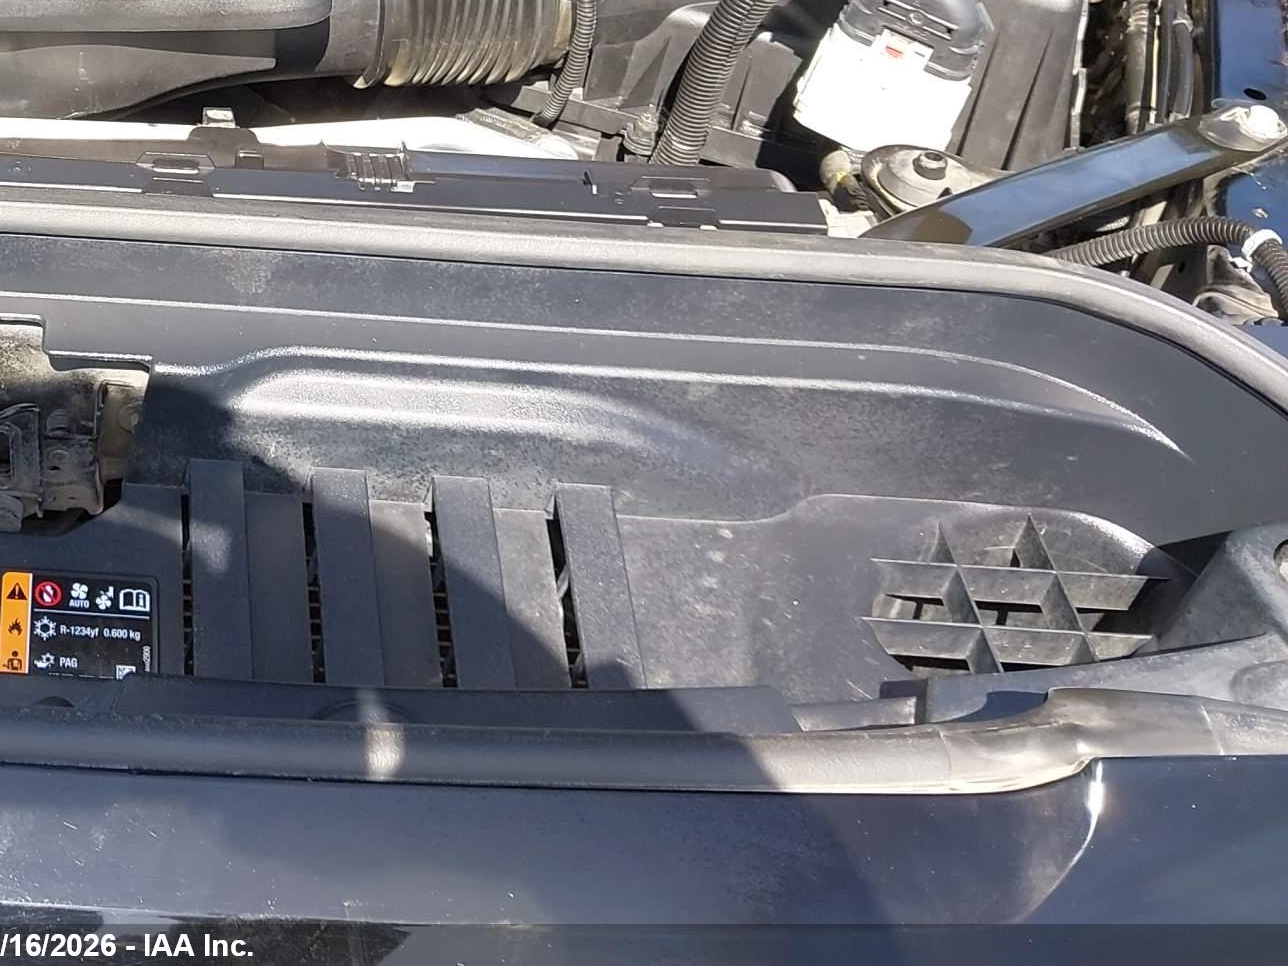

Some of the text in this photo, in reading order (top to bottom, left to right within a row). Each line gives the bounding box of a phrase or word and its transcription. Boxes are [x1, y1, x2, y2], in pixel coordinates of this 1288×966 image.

[69, 599, 89, 608] AUTO
[60, 625, 141, 641] R-1234yf 0.600 kg
[60, 657, 77, 667] PAG
